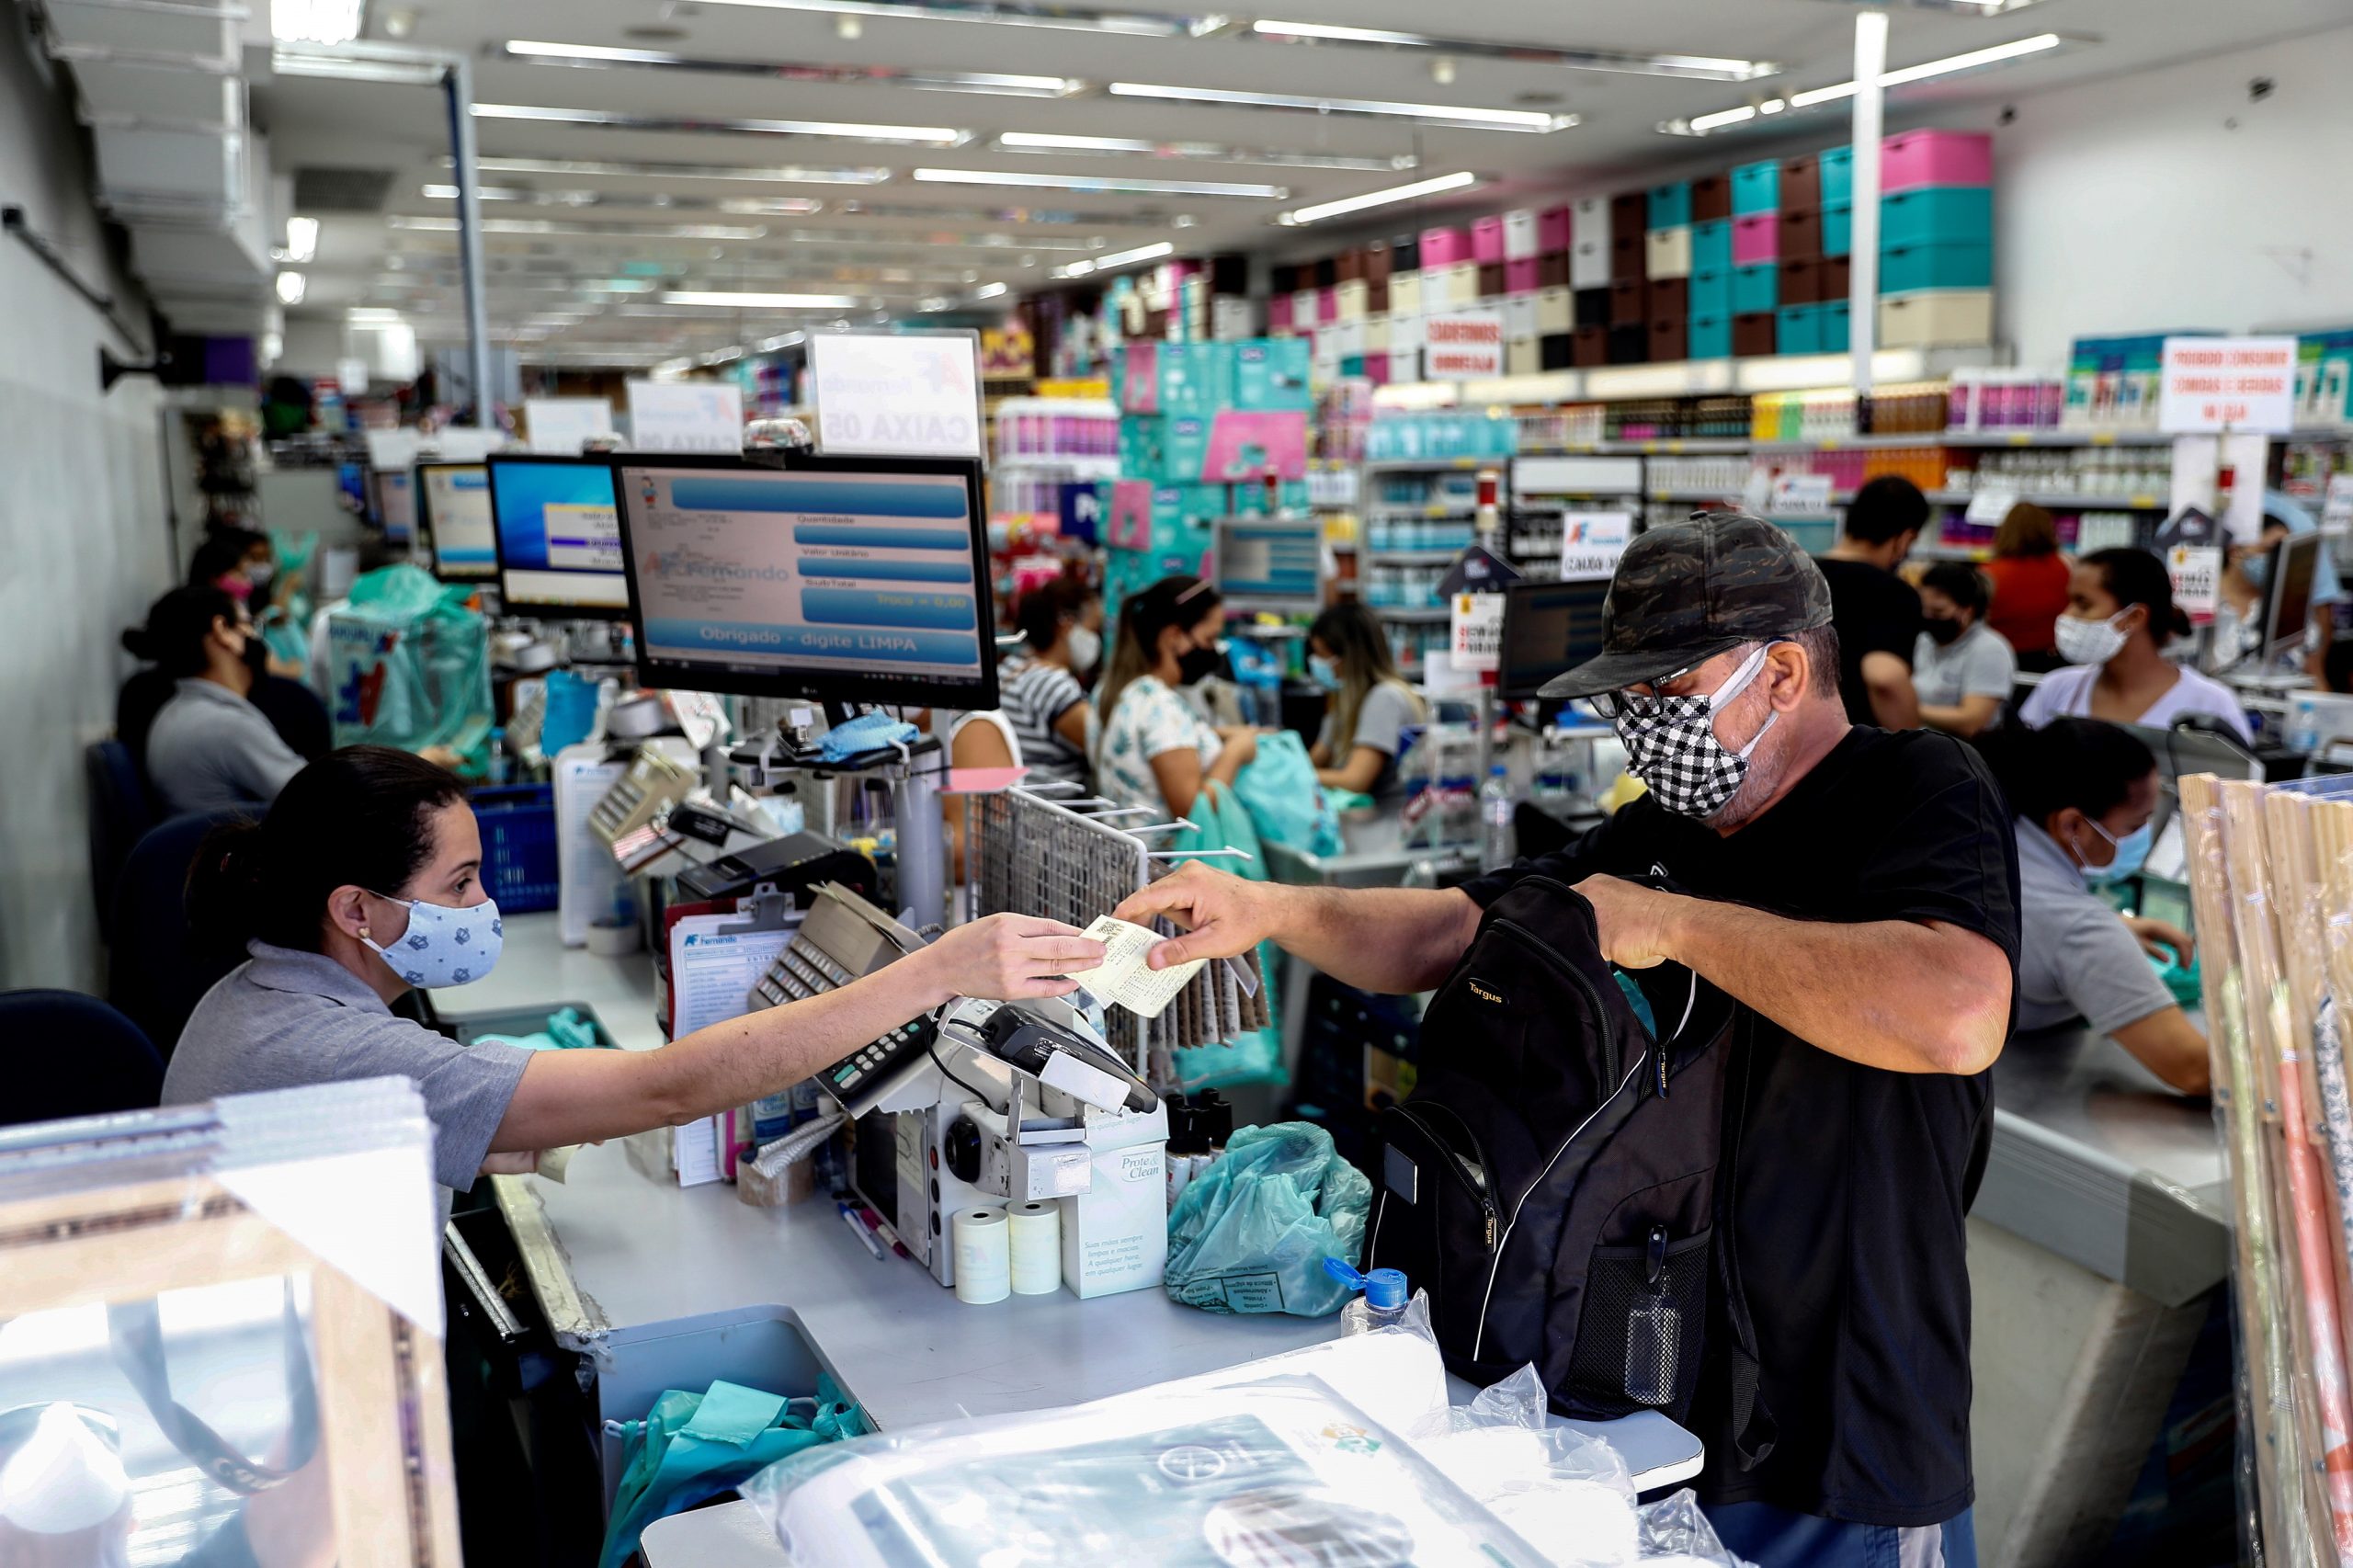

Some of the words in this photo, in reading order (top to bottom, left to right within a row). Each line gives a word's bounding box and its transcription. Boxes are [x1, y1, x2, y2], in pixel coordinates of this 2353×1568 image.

[797, 515, 855, 525] Quantidade
[699, 626, 781, 645] Obrigado
[801, 632, 852, 650] digite
[858, 636, 917, 652] LIMPA
[700, 936, 738, 946] Fernando
[1469, 982, 1503, 1004] Targus
[1121, 1156, 1149, 1169] Prote
[1130, 1166, 1159, 1179] Clean
